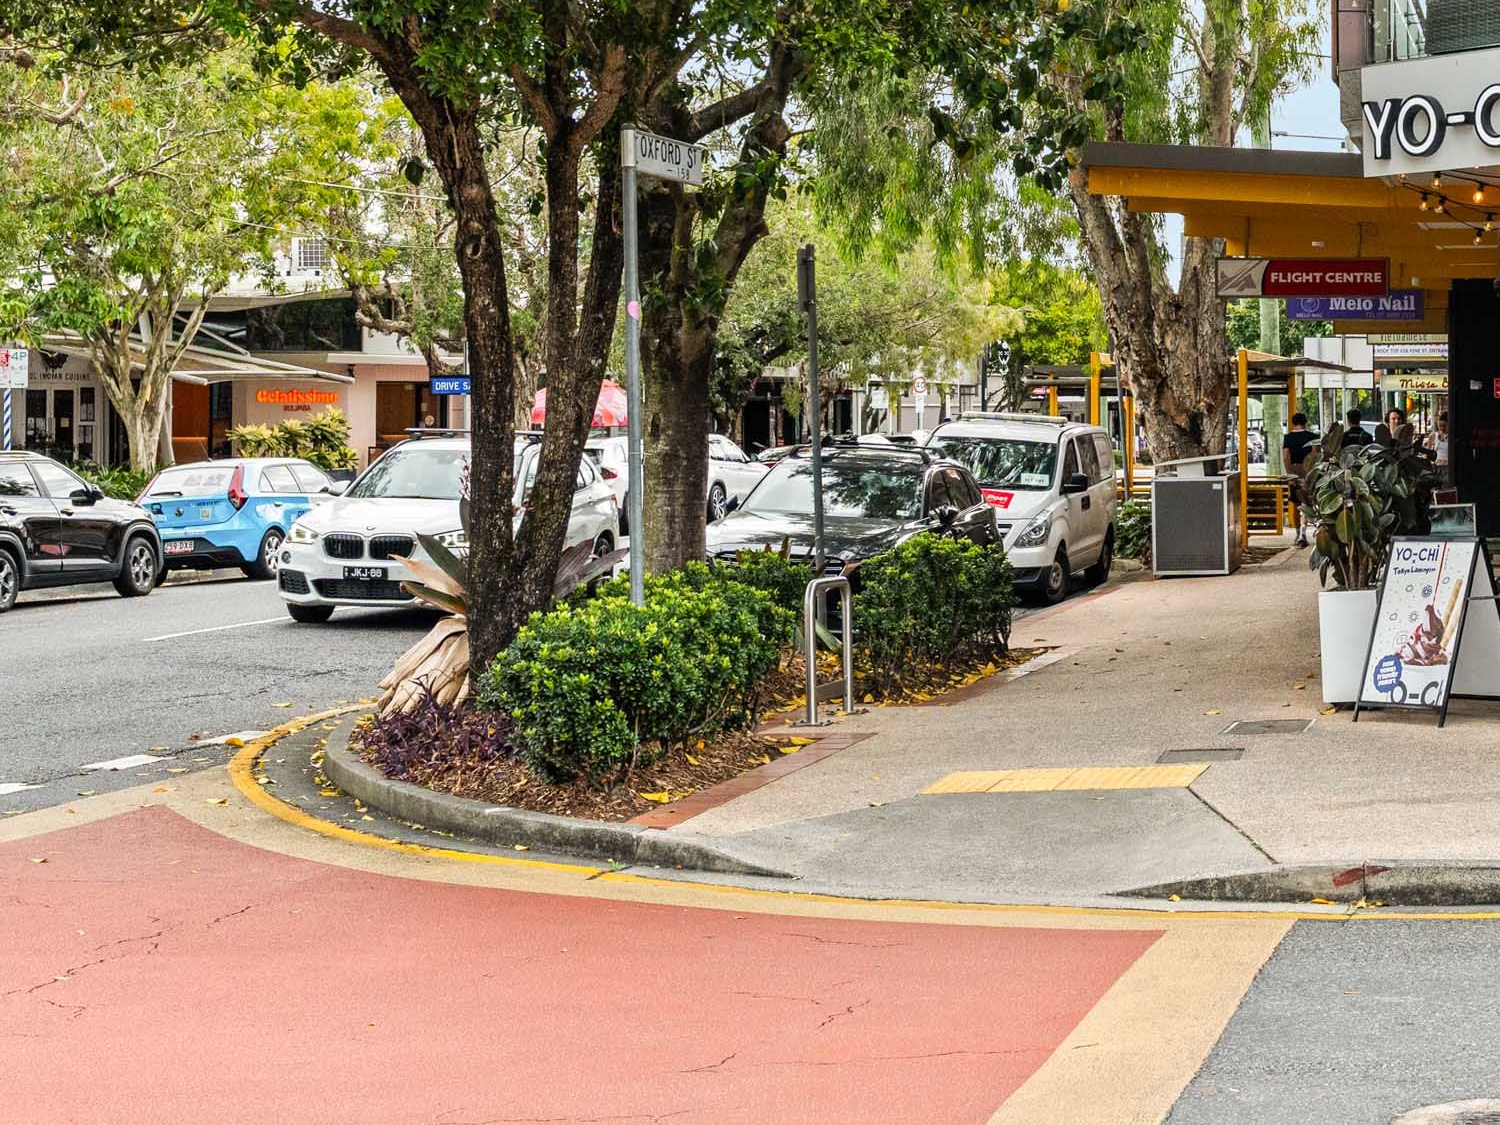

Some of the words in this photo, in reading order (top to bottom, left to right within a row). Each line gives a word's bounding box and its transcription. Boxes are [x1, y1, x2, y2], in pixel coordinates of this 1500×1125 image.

[640, 135, 681, 165] OXFORD
[687, 147, 697, 169] ST
[1270, 272, 1322, 283] FLIGHT
[1325, 272, 1382, 283] CENTRE
[1329, 297, 1373, 311] Melo
[1379, 295, 1416, 311] Nail
[11, 351, 27, 361] 4P
[65, 373, 91, 381] CUISINE
[435, 382, 459, 390] DRIVE
[256, 389, 338, 404] Gelatissimo
